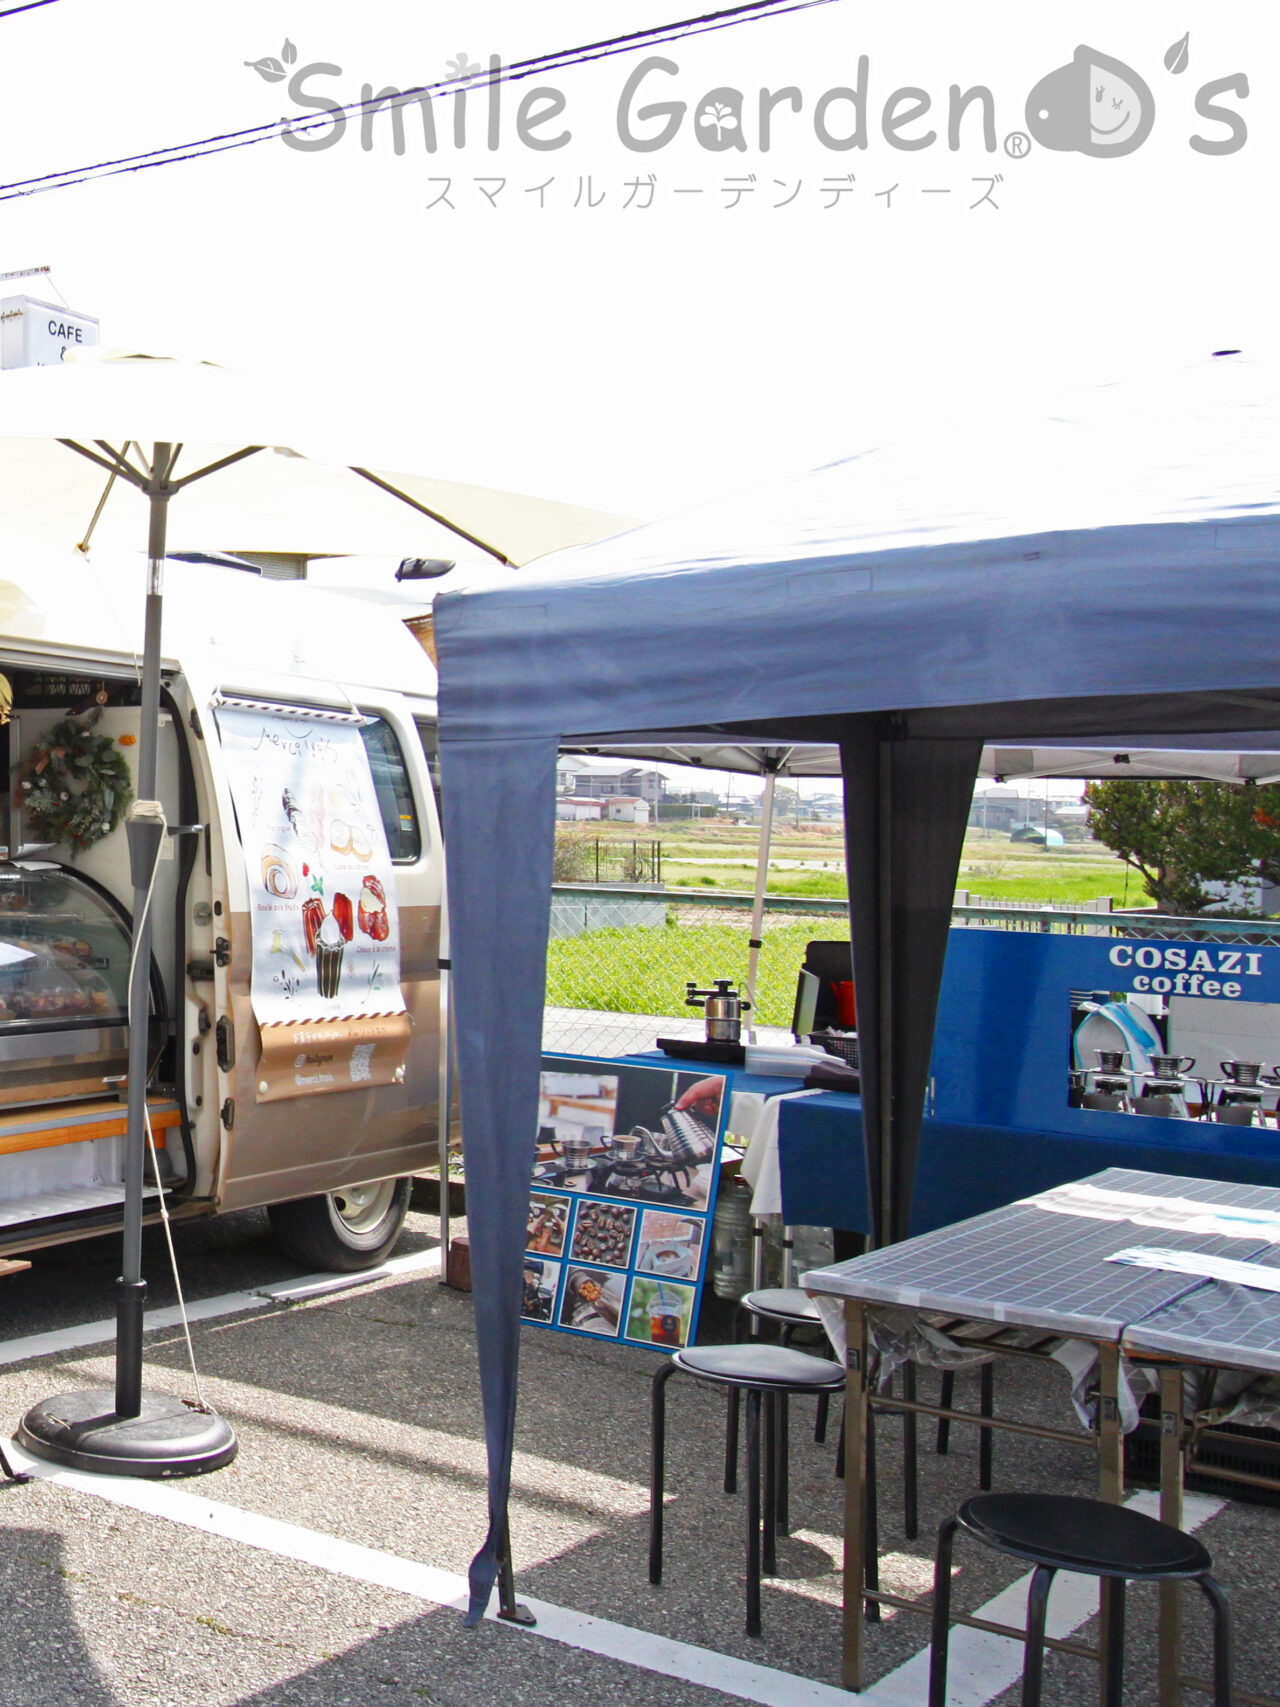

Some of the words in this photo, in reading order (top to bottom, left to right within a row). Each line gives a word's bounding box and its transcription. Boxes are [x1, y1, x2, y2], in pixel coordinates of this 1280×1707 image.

[48, 320, 82, 343] CAFE
[1108, 945, 1263, 976] COSAZI
[1132, 973, 1242, 998] coffee
